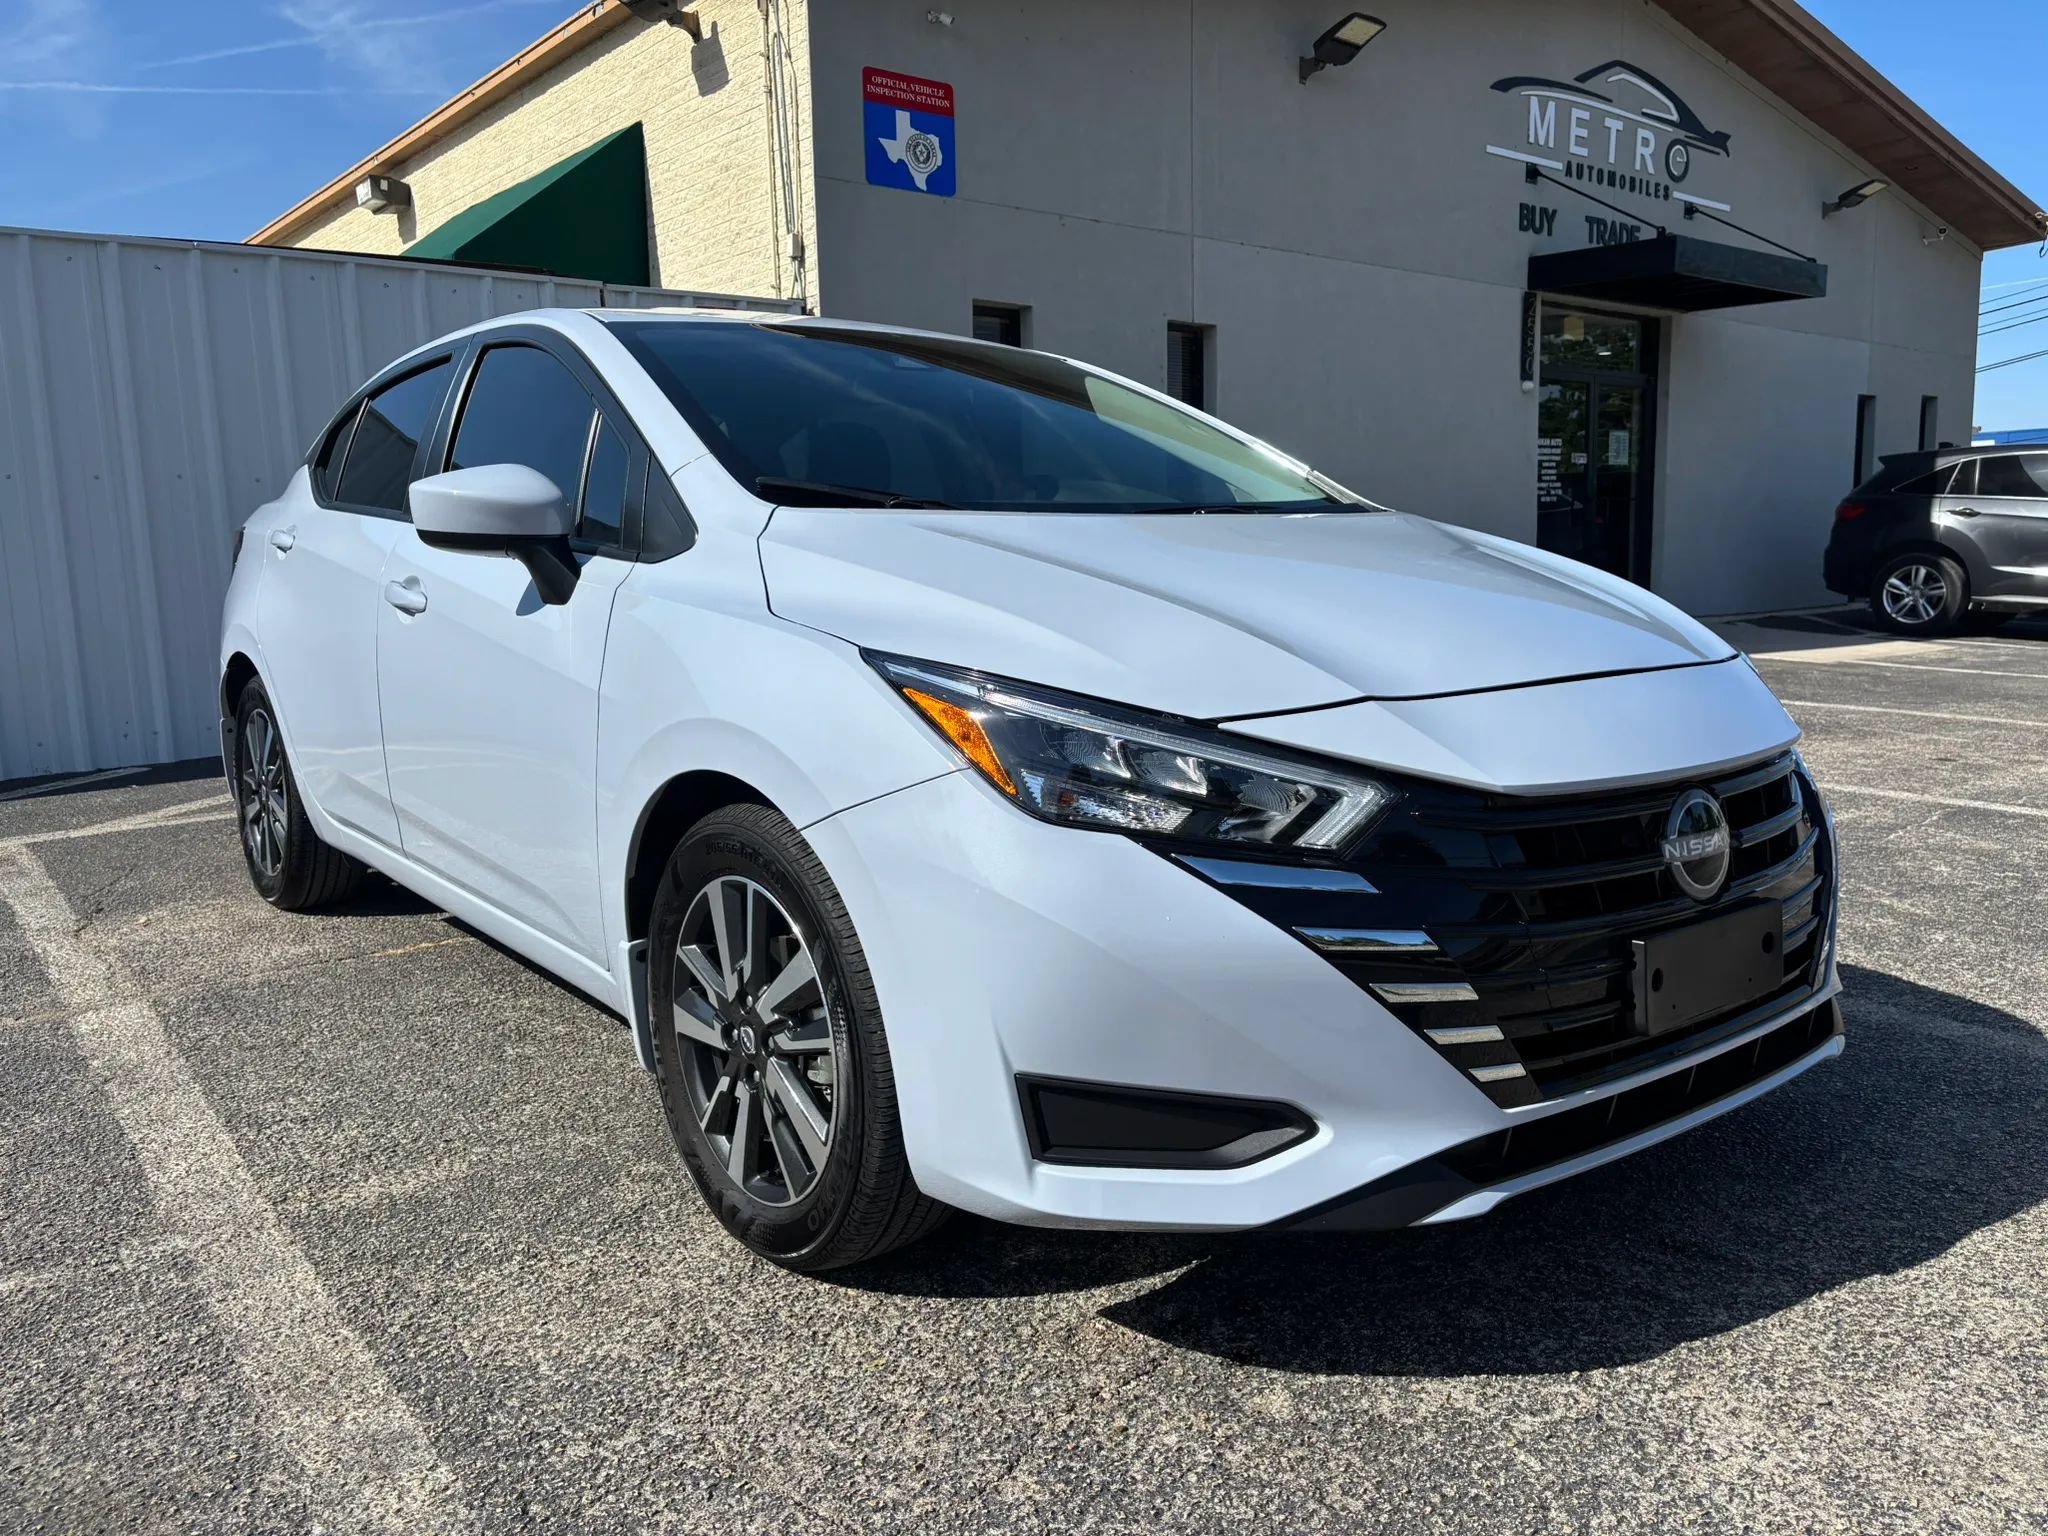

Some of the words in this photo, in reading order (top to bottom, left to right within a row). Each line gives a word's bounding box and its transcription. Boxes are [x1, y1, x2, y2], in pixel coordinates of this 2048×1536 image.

[867, 84, 915, 101] INSPECTION
[916, 94, 950, 108] STATION
[871, 75, 909, 90] OFFICIAL
[911, 83, 945, 98] VEHICLE
[1528, 95, 1690, 183] METRO
[1565, 160, 1671, 202] AUTOMOBILES
[1519, 202, 1557, 237] BUY
[1585, 215, 1641, 248] TRADE
[1665, 830, 1729, 858] NISSAN
